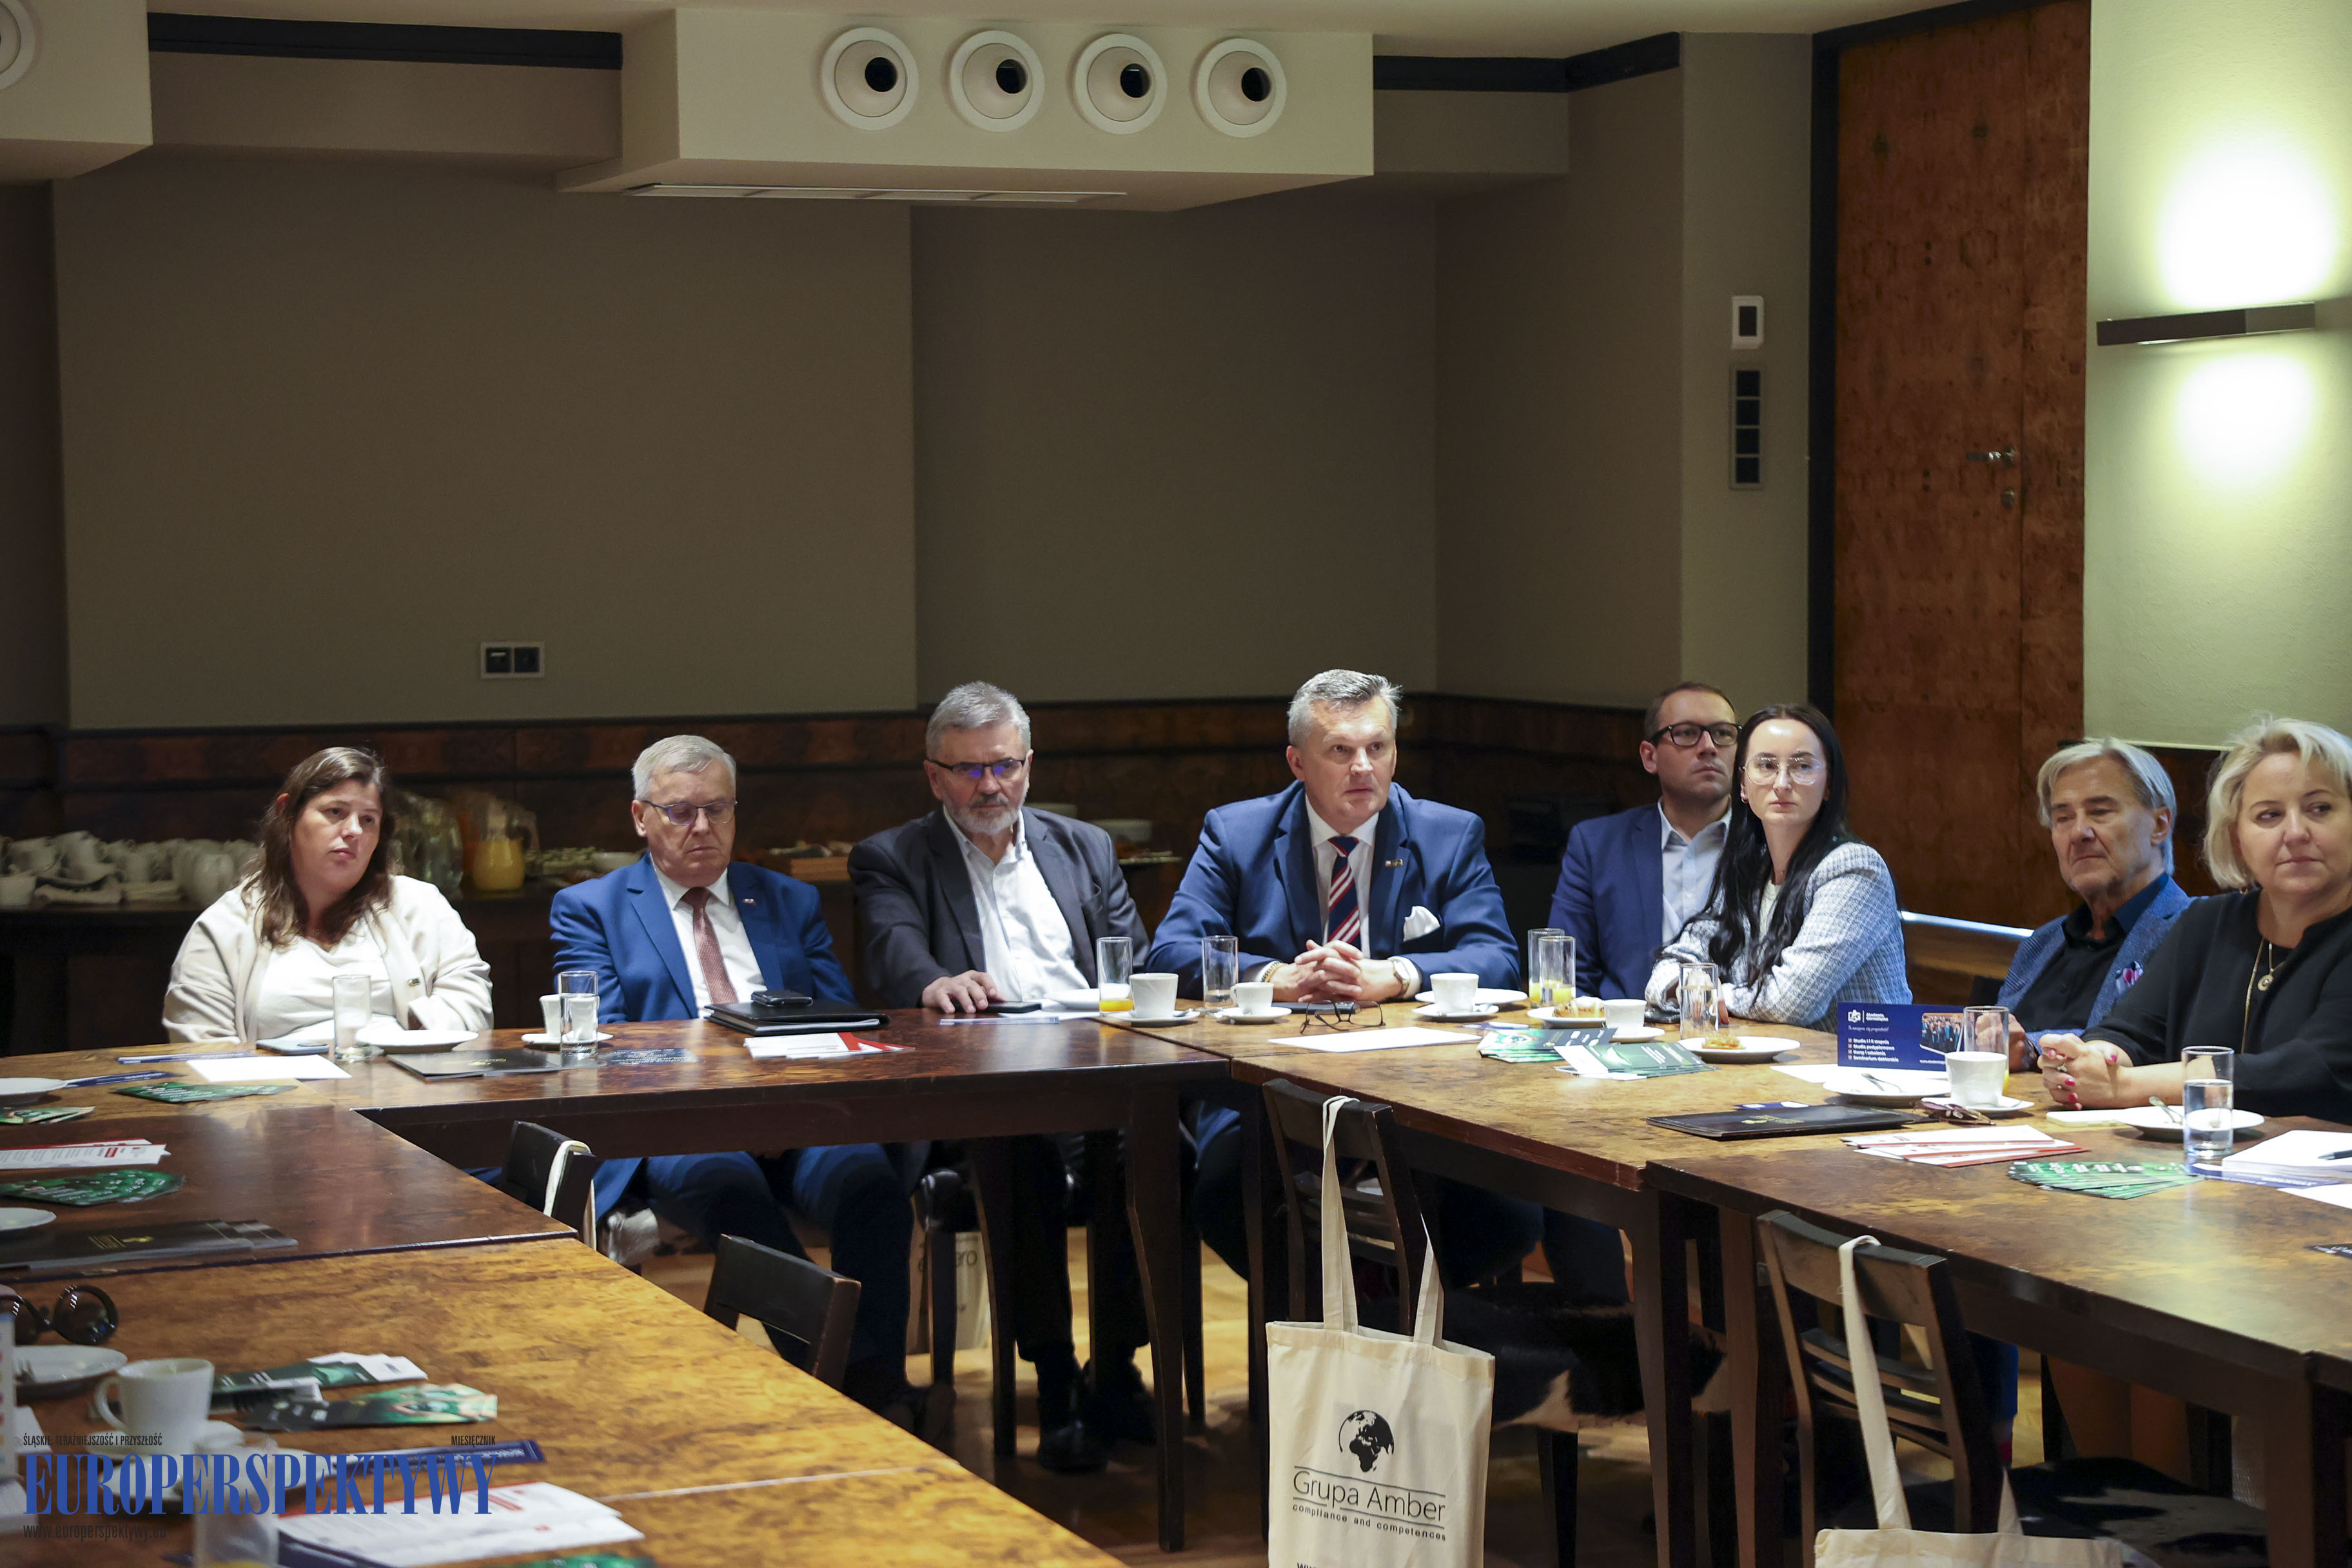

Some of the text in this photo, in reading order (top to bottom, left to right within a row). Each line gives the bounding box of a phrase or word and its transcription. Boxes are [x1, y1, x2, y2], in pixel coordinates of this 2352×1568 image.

[1293, 1471, 1446, 1521] Grupa Amber
[1293, 1504, 1446, 1541] compliance and competences
